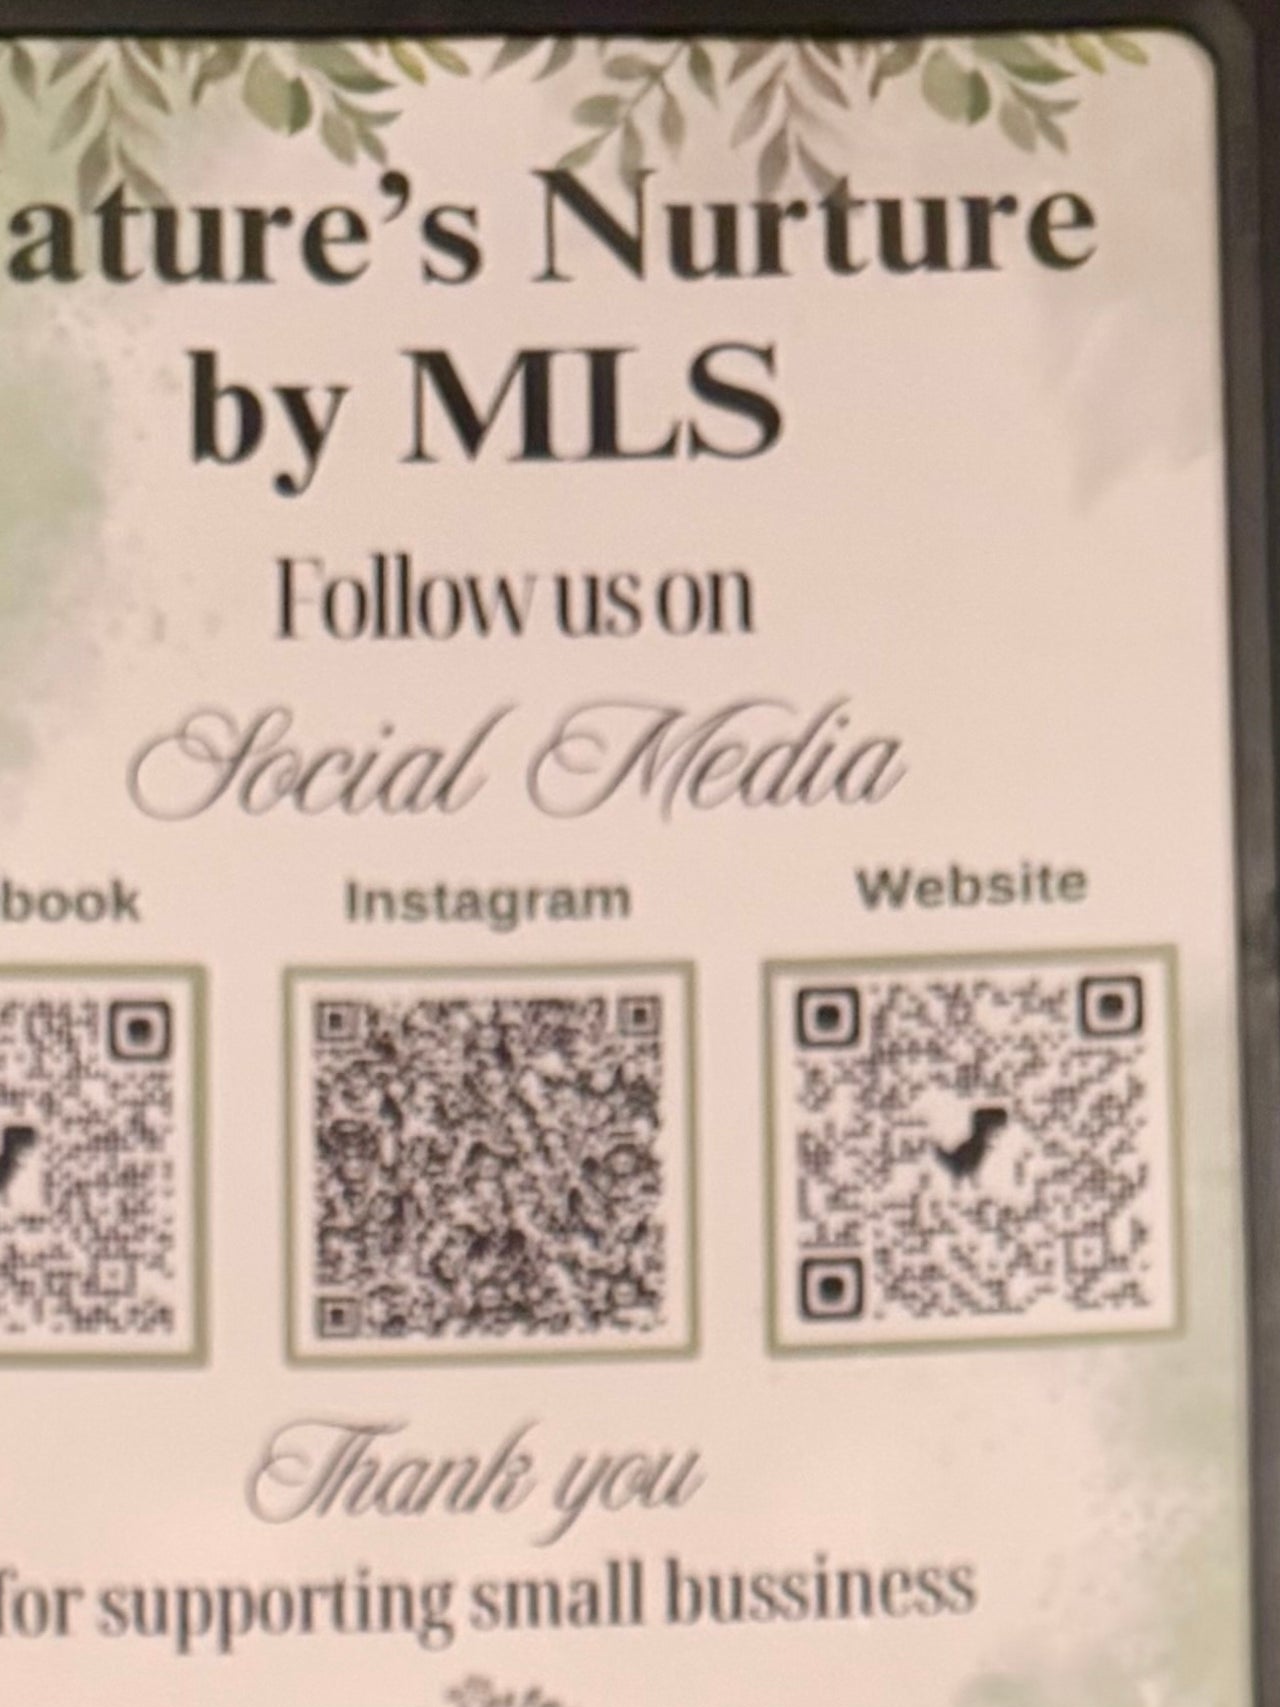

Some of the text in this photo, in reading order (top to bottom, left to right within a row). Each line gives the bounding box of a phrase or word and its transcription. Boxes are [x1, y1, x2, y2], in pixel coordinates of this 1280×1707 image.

[530, 168, 1097, 283] Nurture
[187, 341, 784, 497] by MLS
[276, 551, 754, 640] Follow us on
[125, 697, 908, 824] Social Media
[345, 879, 632, 934] Instagram
[854, 860, 1088, 912] Website
[246, 1418, 704, 1548] Thank you
[98, 1567, 456, 1656] supporting
[470, 1557, 645, 1630] small
[665, 1553, 978, 1626] bussiness
